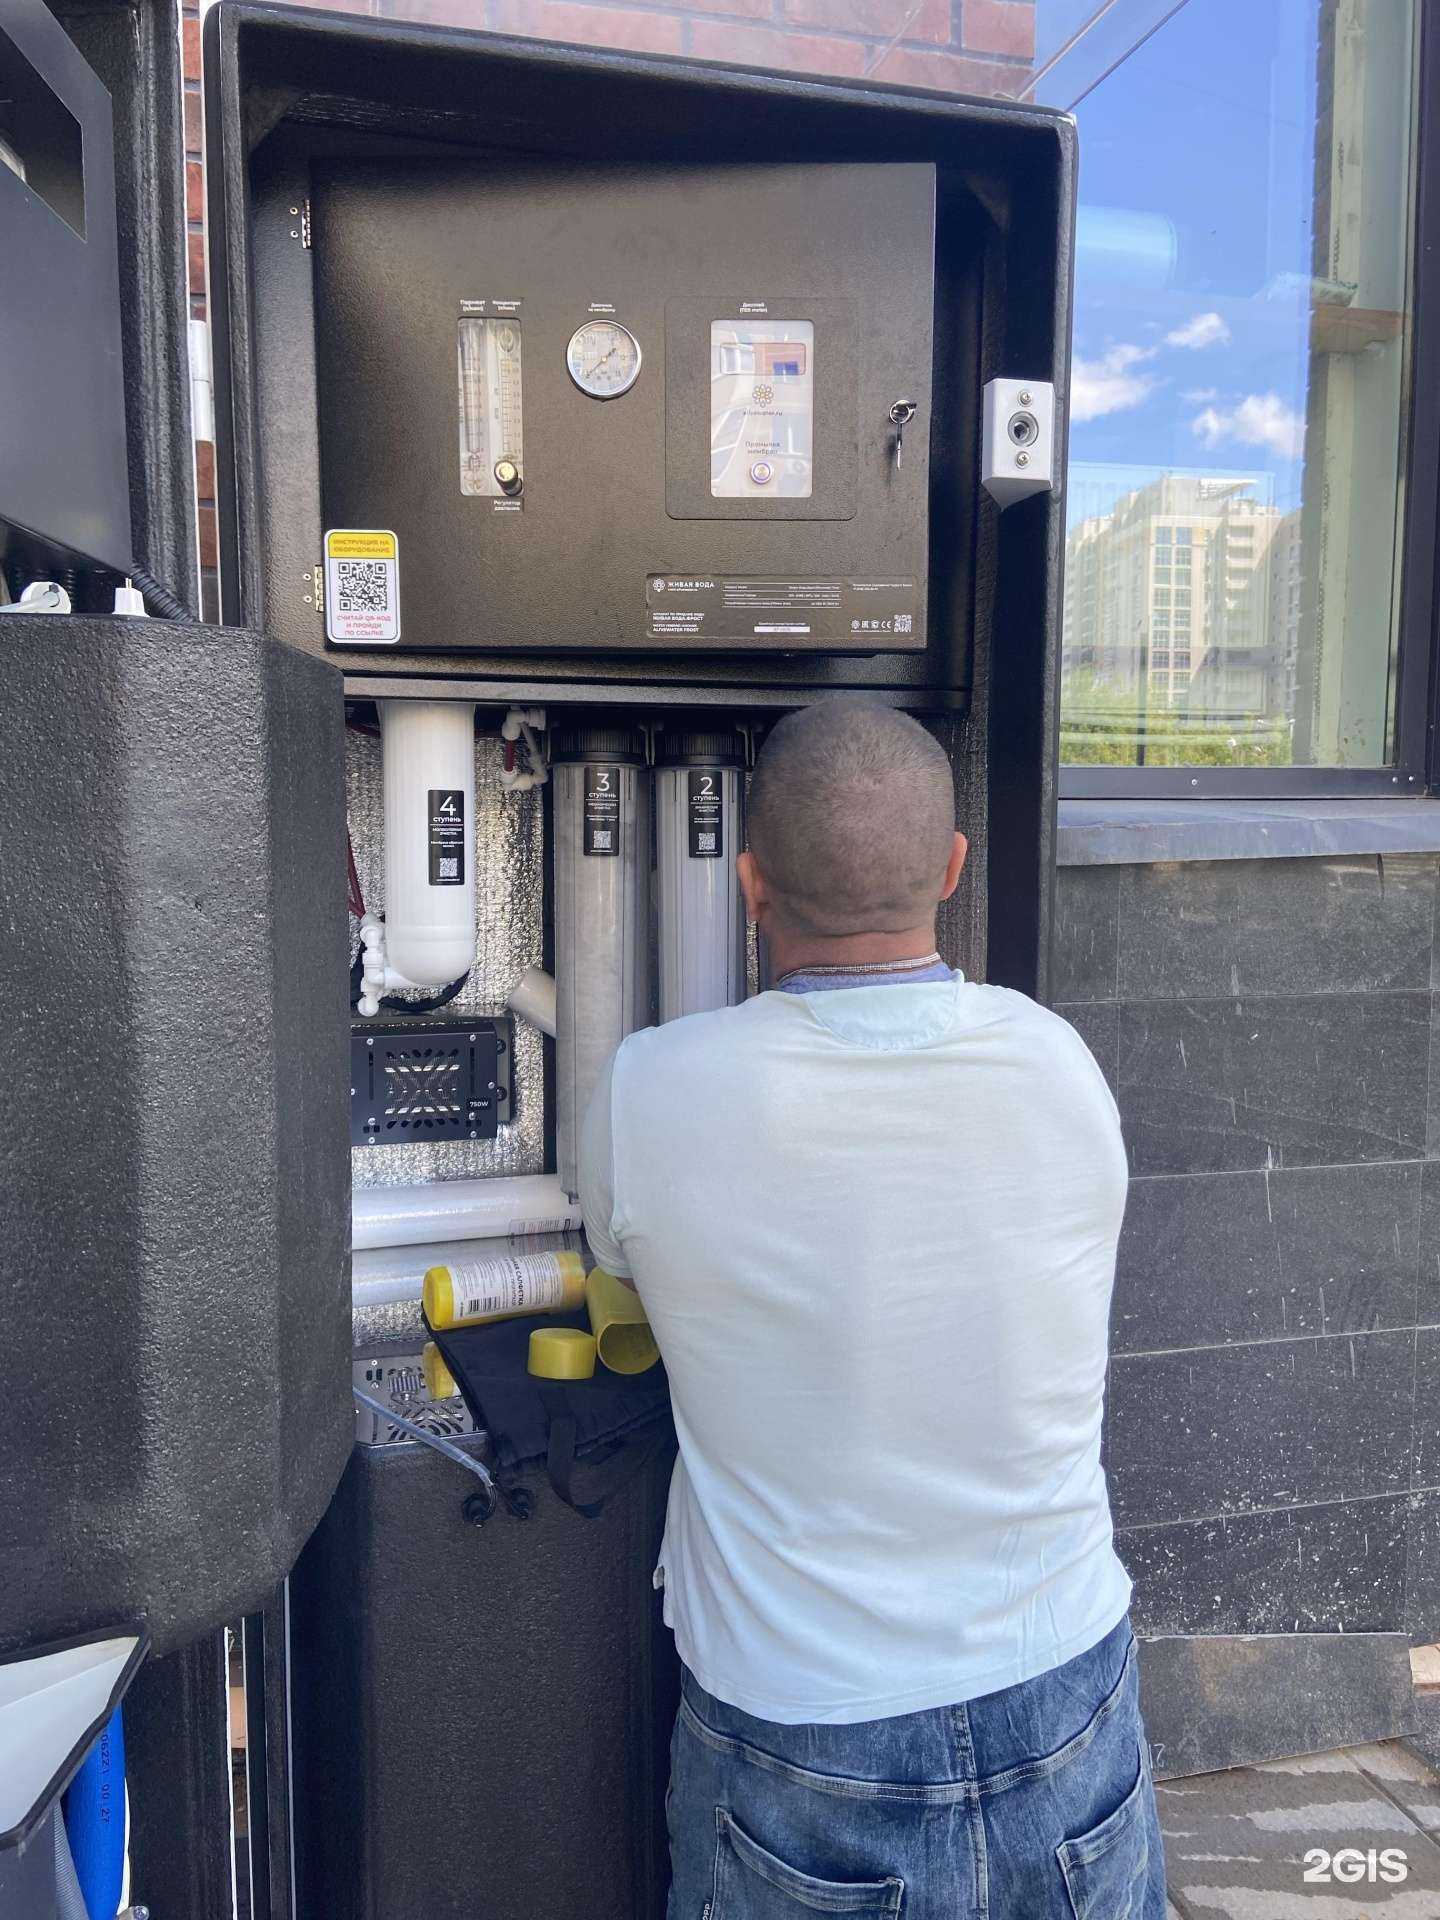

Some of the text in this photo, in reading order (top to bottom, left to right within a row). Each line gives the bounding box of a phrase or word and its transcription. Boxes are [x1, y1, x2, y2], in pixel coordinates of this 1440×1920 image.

[352, 621, 381, 629] ПРОЙДИ
[596, 773, 610, 792] 3
[700, 777, 714, 795] 2
[440, 796, 456, 816] 4
[516, 1270, 524, 1306] САЛФЕТКА
